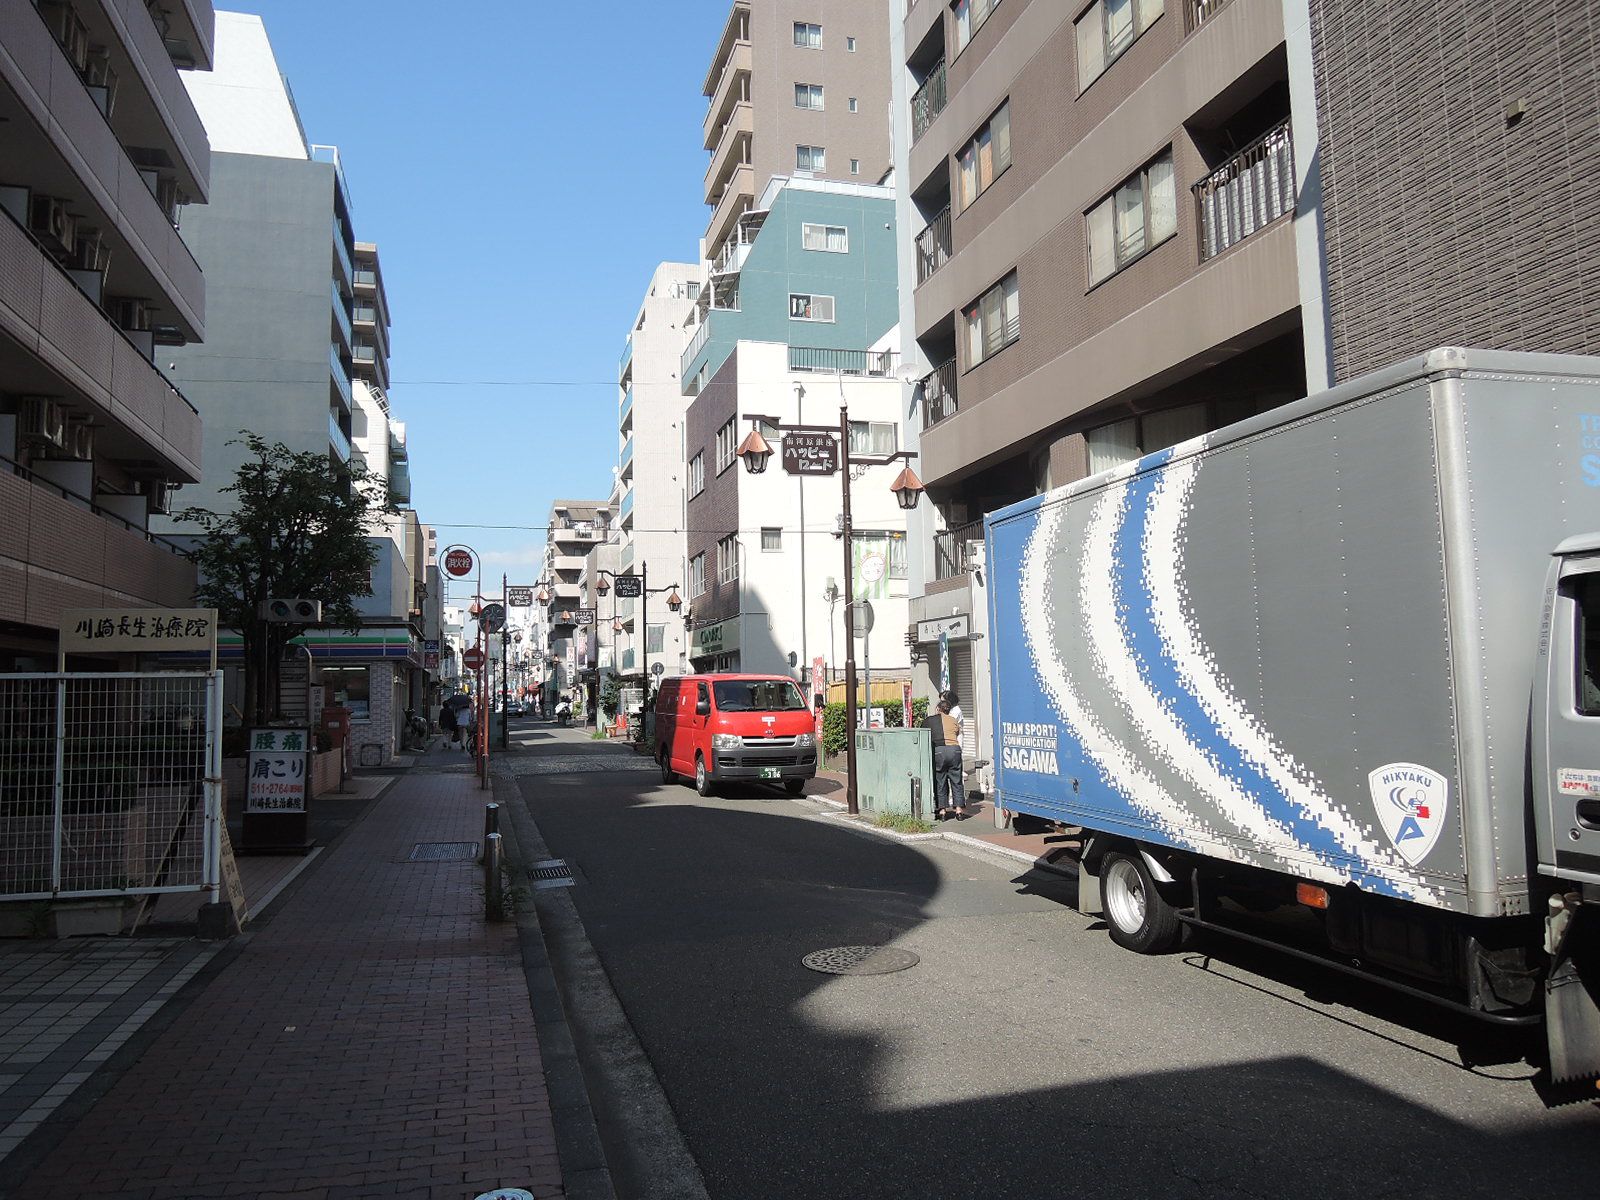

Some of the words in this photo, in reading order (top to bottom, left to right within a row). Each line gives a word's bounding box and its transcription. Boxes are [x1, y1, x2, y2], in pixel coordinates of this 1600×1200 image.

[785, 437, 833, 446] 南河原銀座
[785, 447, 830, 459] ハッピー
[798, 459, 832, 470] ロード
[447, 557, 471, 568] 消火栓
[75, 615, 209, 639] 川崎長生治療院
[254, 731, 303, 750] 腰痛
[1003, 735, 1057, 749] COMMUNICATION
[1003, 746, 1059, 775] SAGAWA
[252, 758, 304, 779] 肩こり
[1382, 771, 1432, 787] HIKYAKU
[249, 797, 302, 809] 川崎長生治療院
